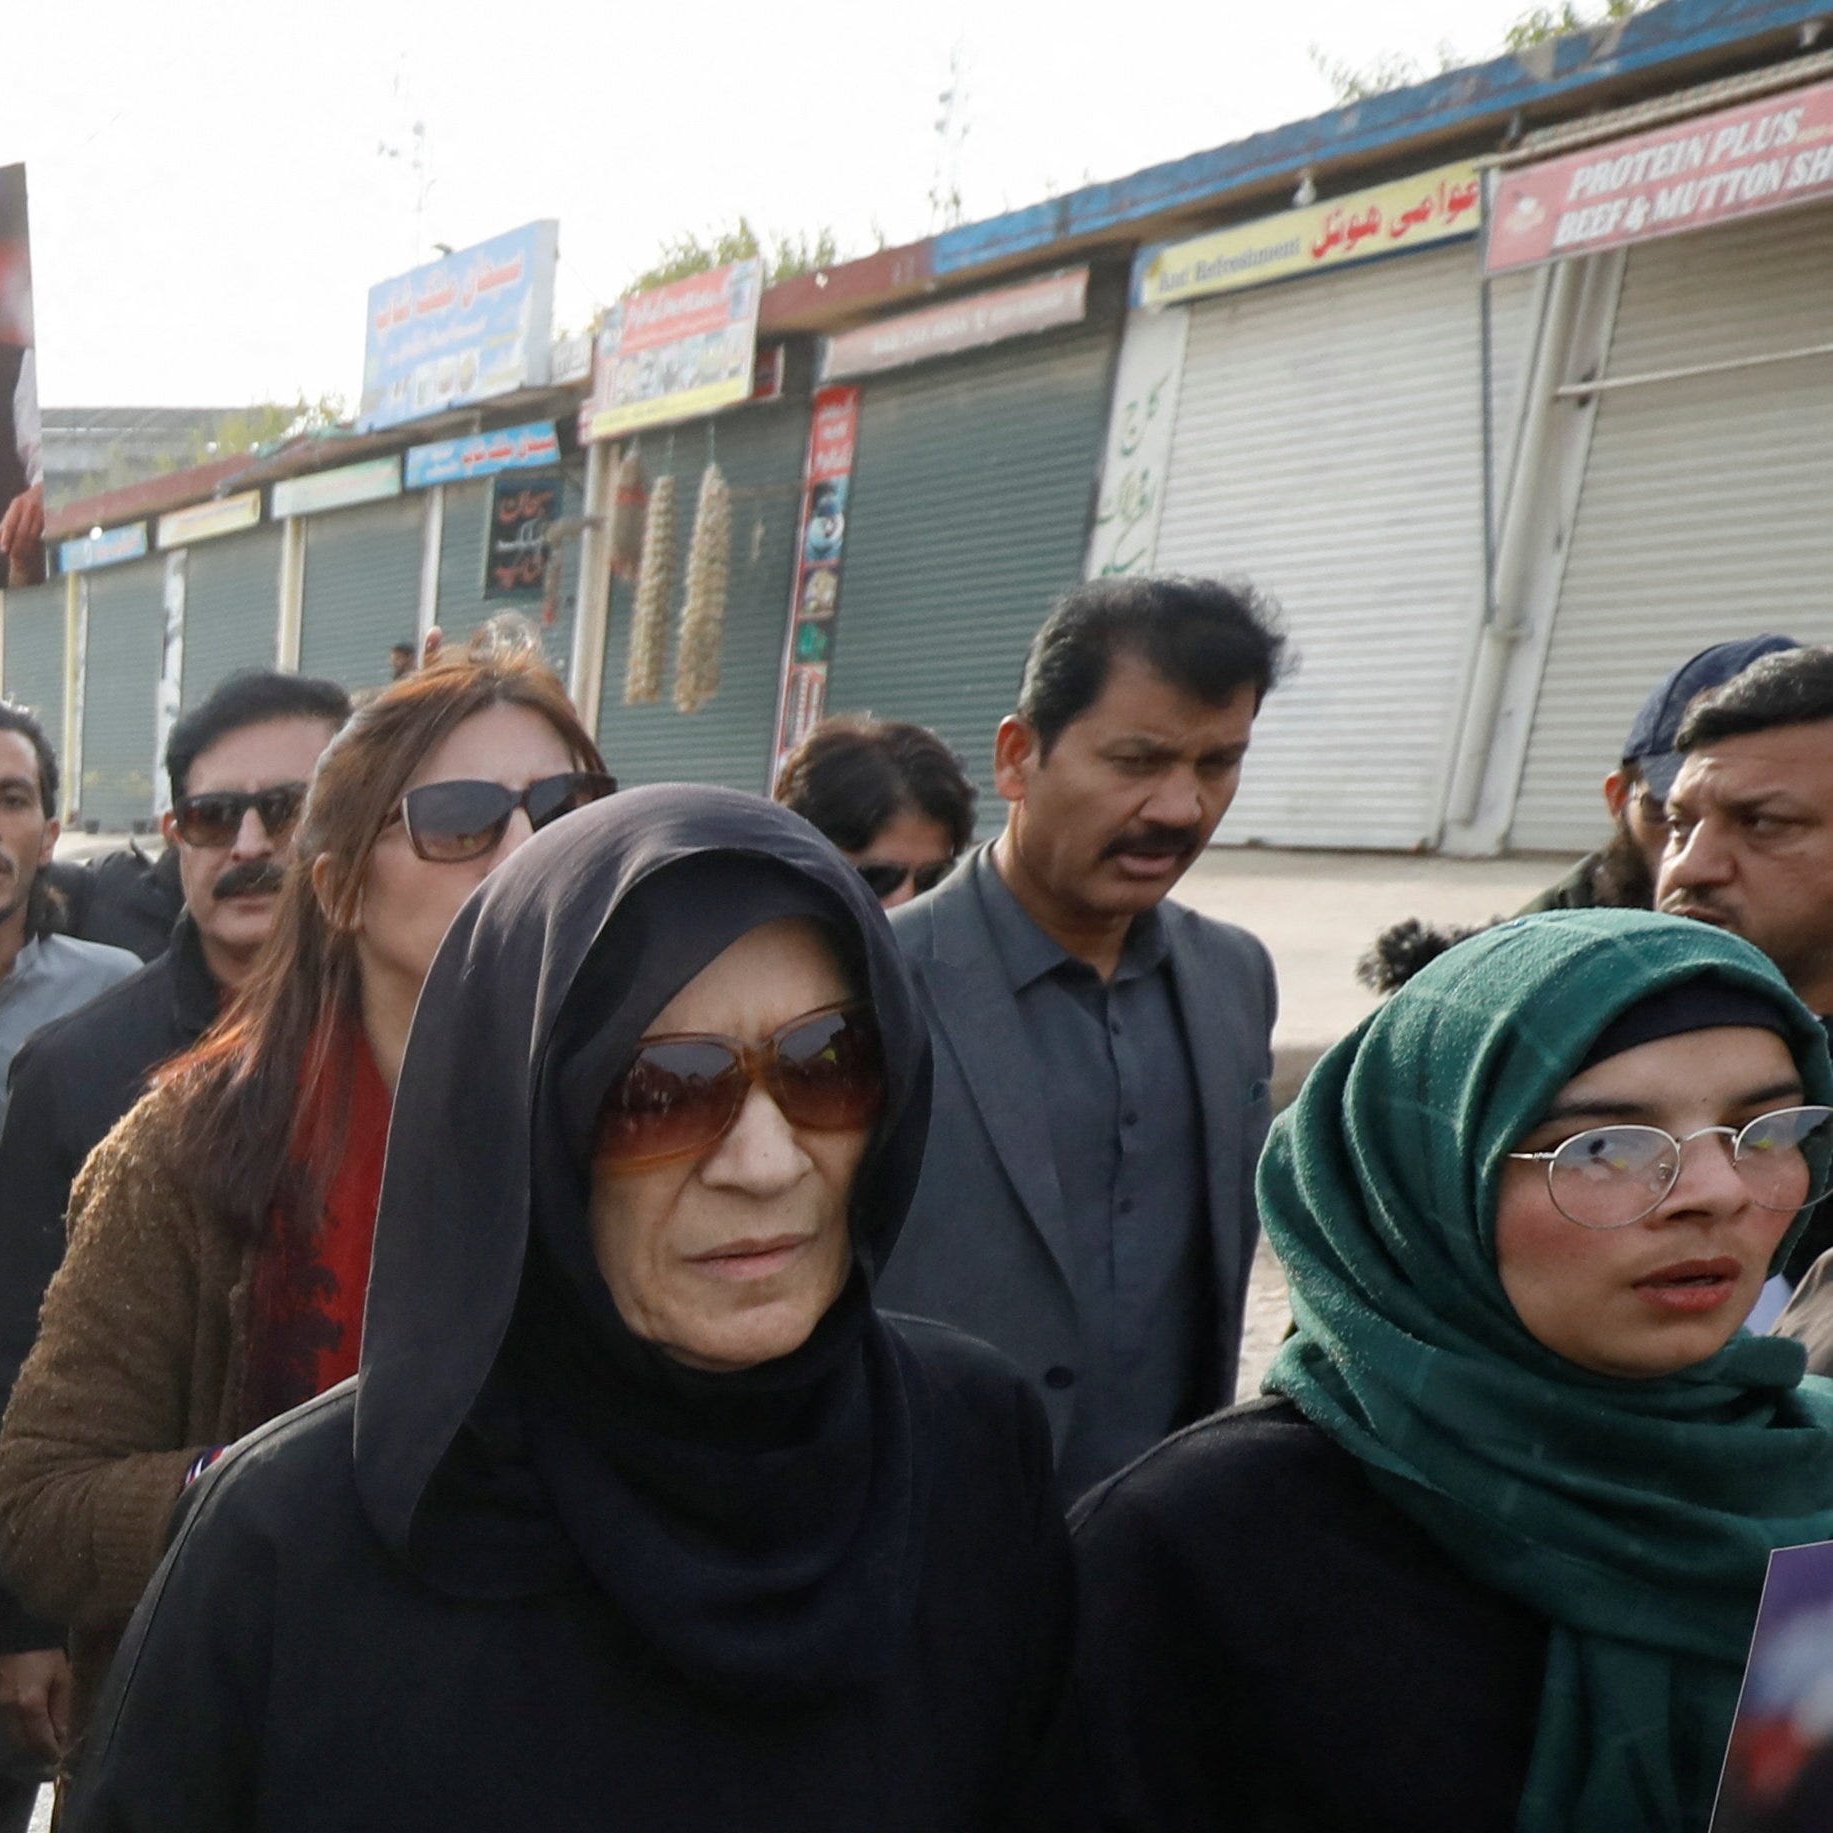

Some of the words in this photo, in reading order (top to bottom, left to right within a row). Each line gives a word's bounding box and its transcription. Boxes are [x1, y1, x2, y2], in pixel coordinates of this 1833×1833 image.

[1553, 198, 1625, 248] BEEF
[1623, 196, 1650, 232] &
[1652, 155, 1791, 222] MUTTON
[1568, 131, 1712, 200] PROTEIN
